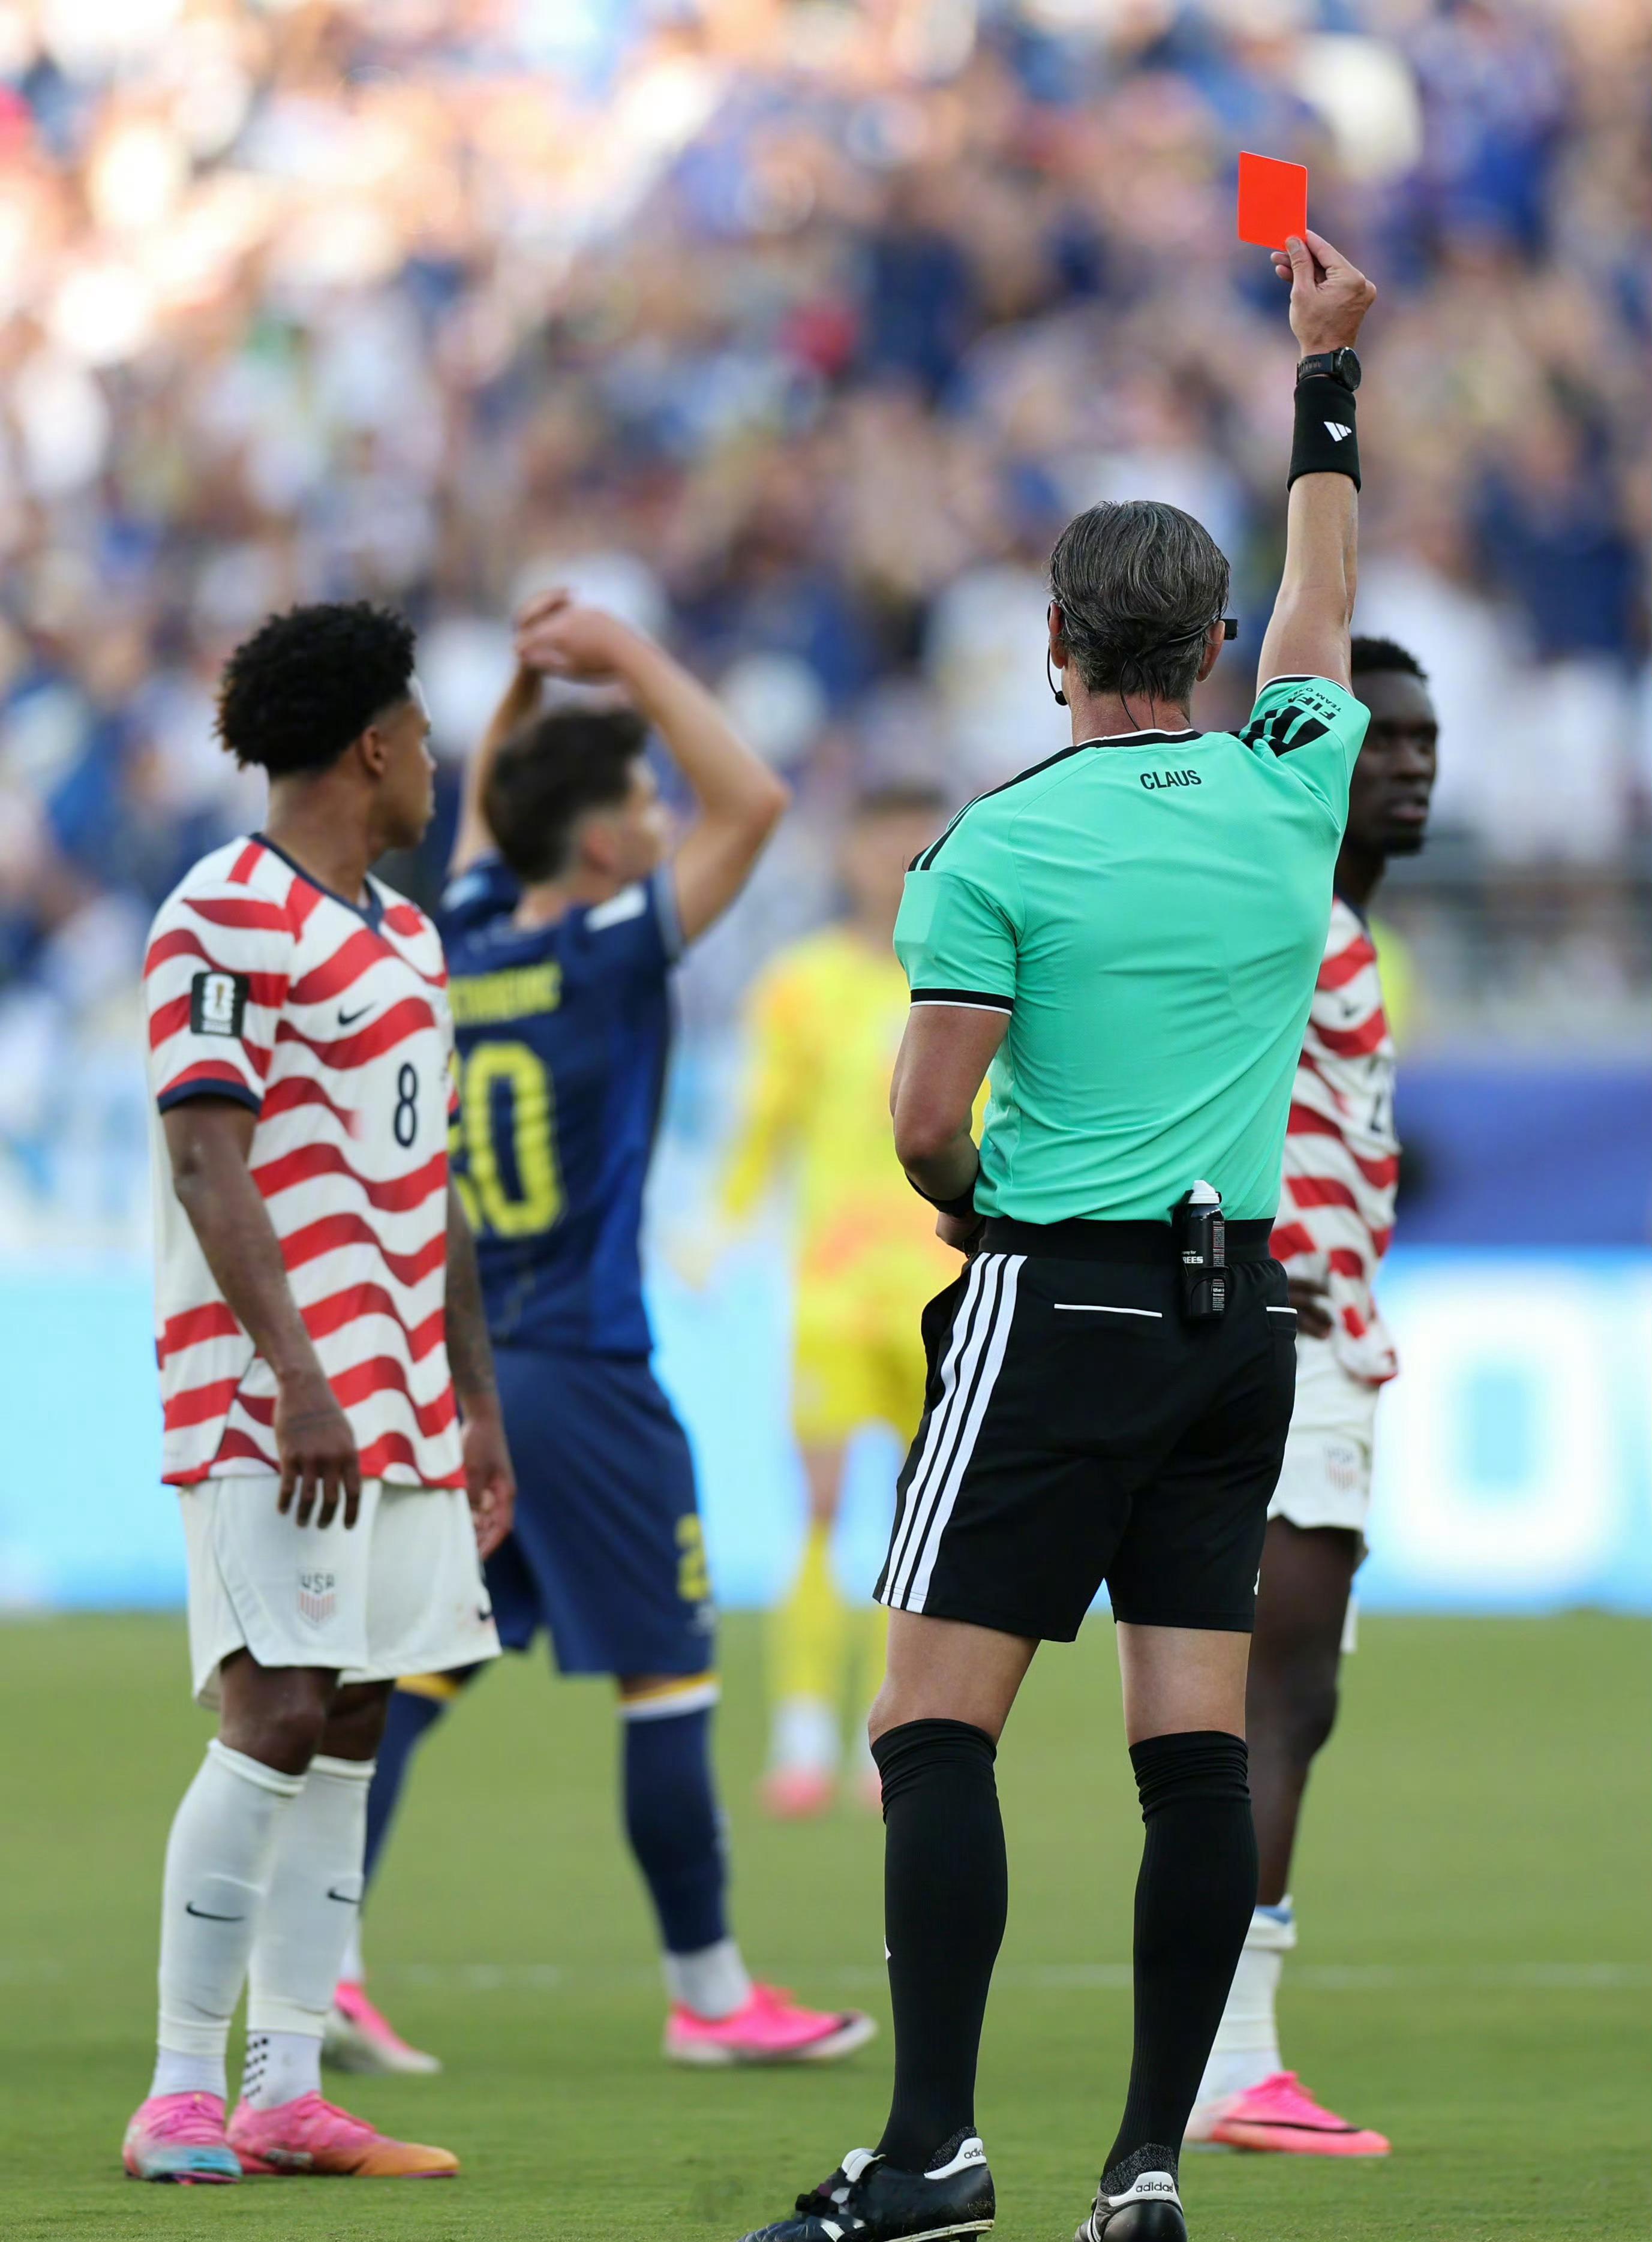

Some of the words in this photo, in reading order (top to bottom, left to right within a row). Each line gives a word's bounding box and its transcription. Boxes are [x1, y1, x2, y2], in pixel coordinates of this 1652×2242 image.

[1315, 693, 1342, 713] TEAM
[1140, 770, 1202, 790] CLAUS
[394, 1062, 417, 1149] 8
[448, 1041, 564, 1238] 0
[301, 1571, 335, 1594] USA
[1136, 2181, 1174, 2193] adidas
